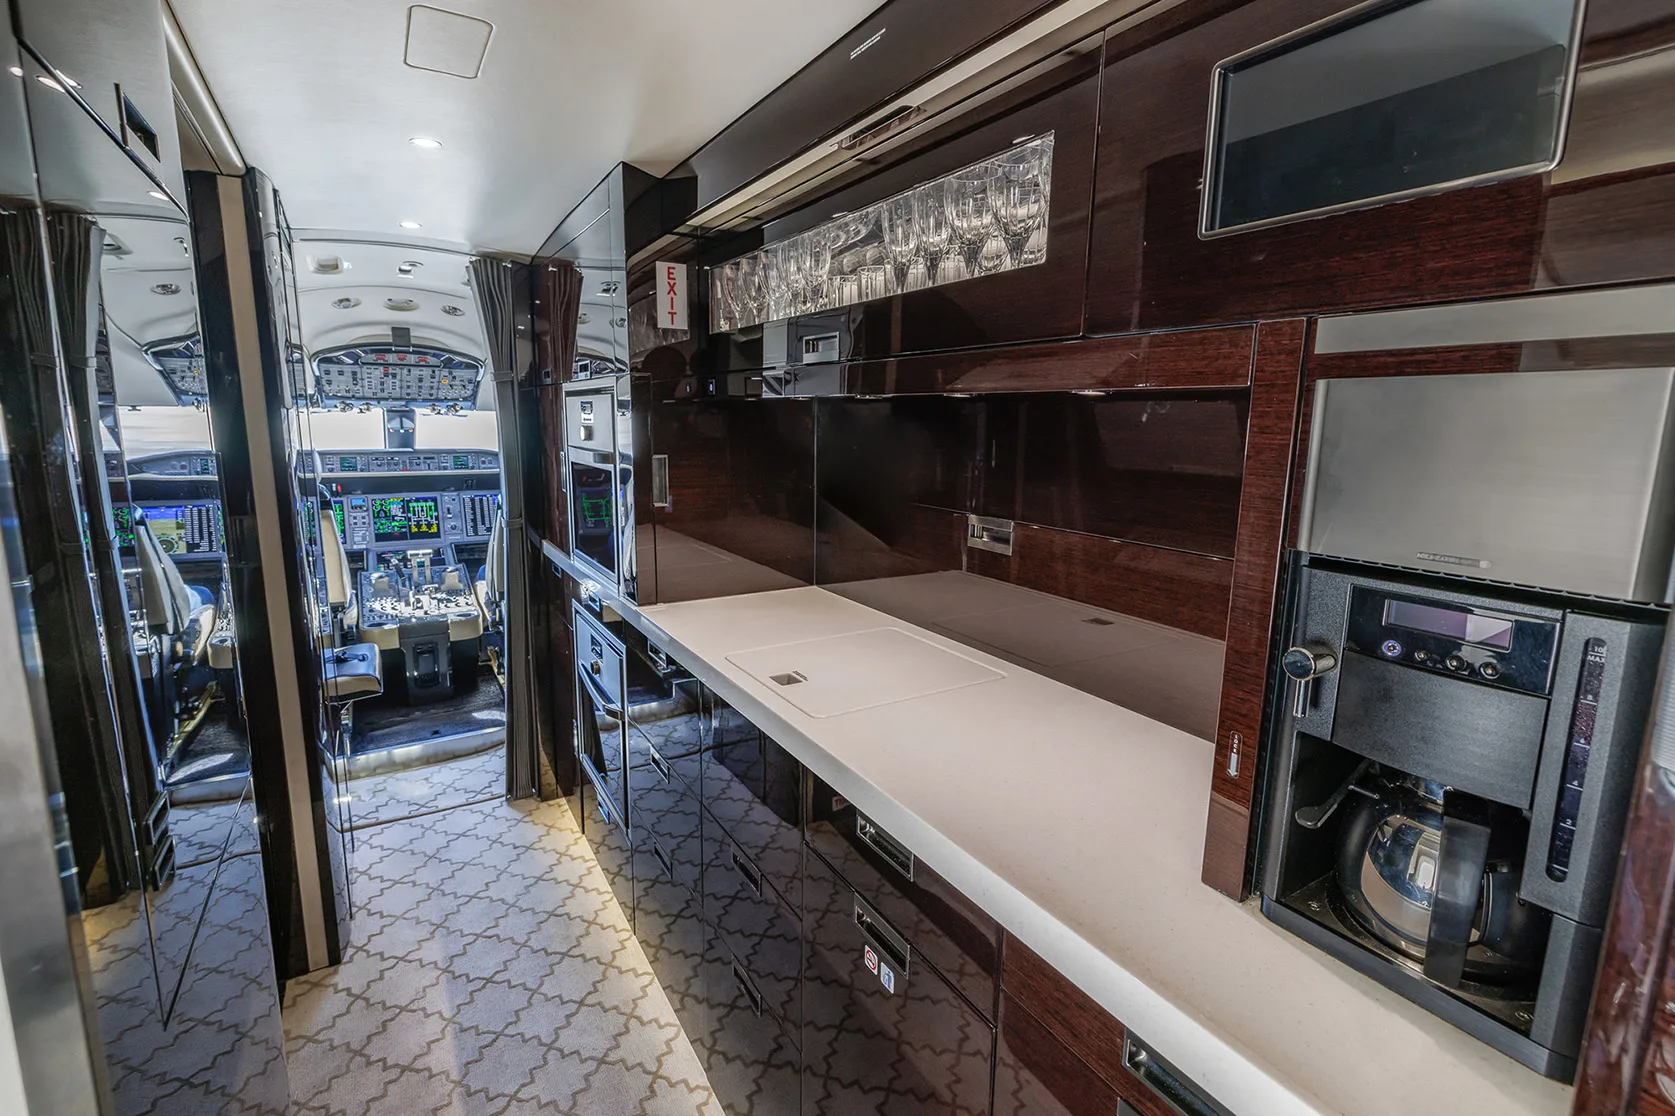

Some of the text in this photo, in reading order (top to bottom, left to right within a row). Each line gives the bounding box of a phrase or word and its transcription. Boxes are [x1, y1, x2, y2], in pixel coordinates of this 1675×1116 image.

[667, 266, 677, 326] EXIT
[1594, 646, 1604, 654] 10
[1587, 655, 1606, 663] MAX
